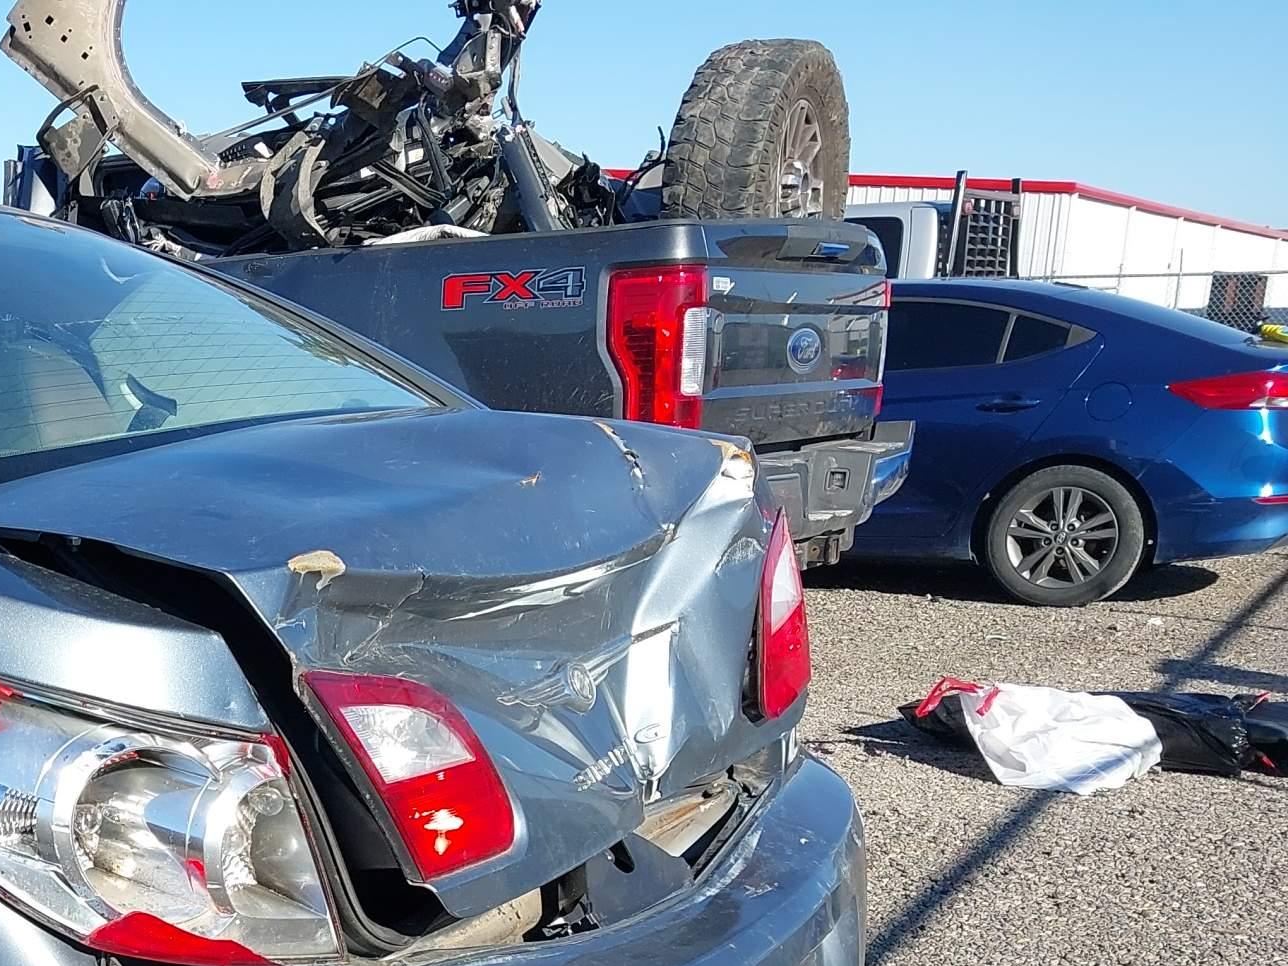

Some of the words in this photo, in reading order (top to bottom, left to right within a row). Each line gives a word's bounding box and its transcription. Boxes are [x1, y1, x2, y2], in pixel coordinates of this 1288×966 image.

[441, 266, 587, 311] FX4
[503, 301, 535, 310] OFF
[540, 299, 584, 308] ROAD
